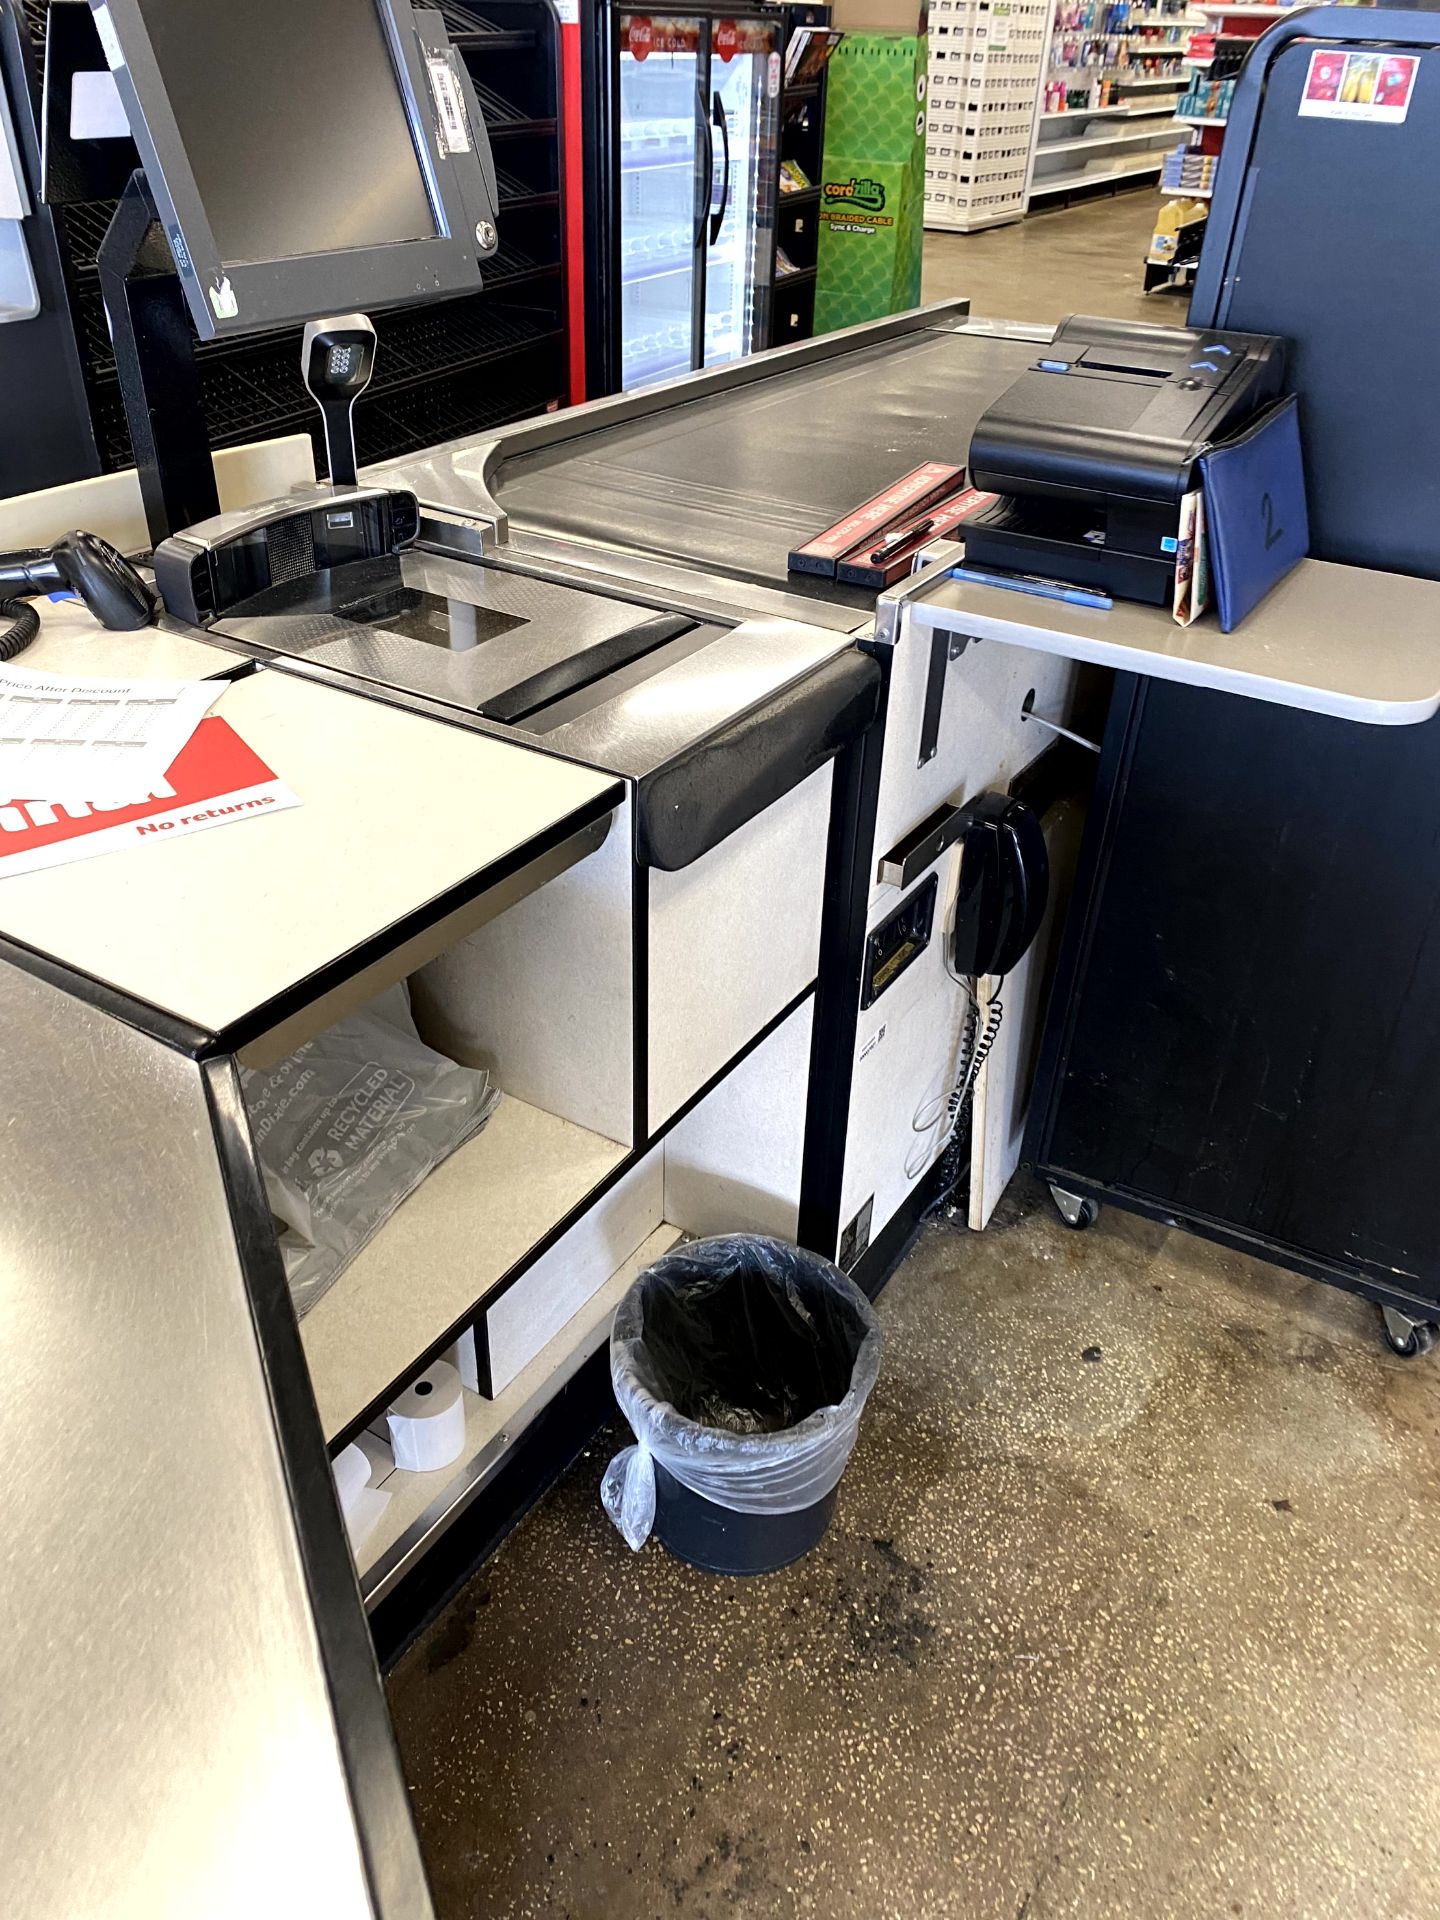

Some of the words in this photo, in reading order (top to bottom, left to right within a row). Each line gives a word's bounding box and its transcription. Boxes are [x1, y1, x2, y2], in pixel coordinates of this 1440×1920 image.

[830, 213, 865, 223] BRAIDED
[866, 217, 893, 225] CABLE
[852, 226, 876, 234] Charge
[859, 503, 894, 521] HERE
[1262, 491, 1284, 552] 2
[0, 678, 32, 690] Price
[34, 685, 69, 693] After
[136, 822, 175, 835] No
[180, 796, 276, 825] returns
[326, 1068, 388, 1142] RECYCLED
[344, 1080, 407, 1151] MATERIAL
[296, 1118, 322, 1152] contains
